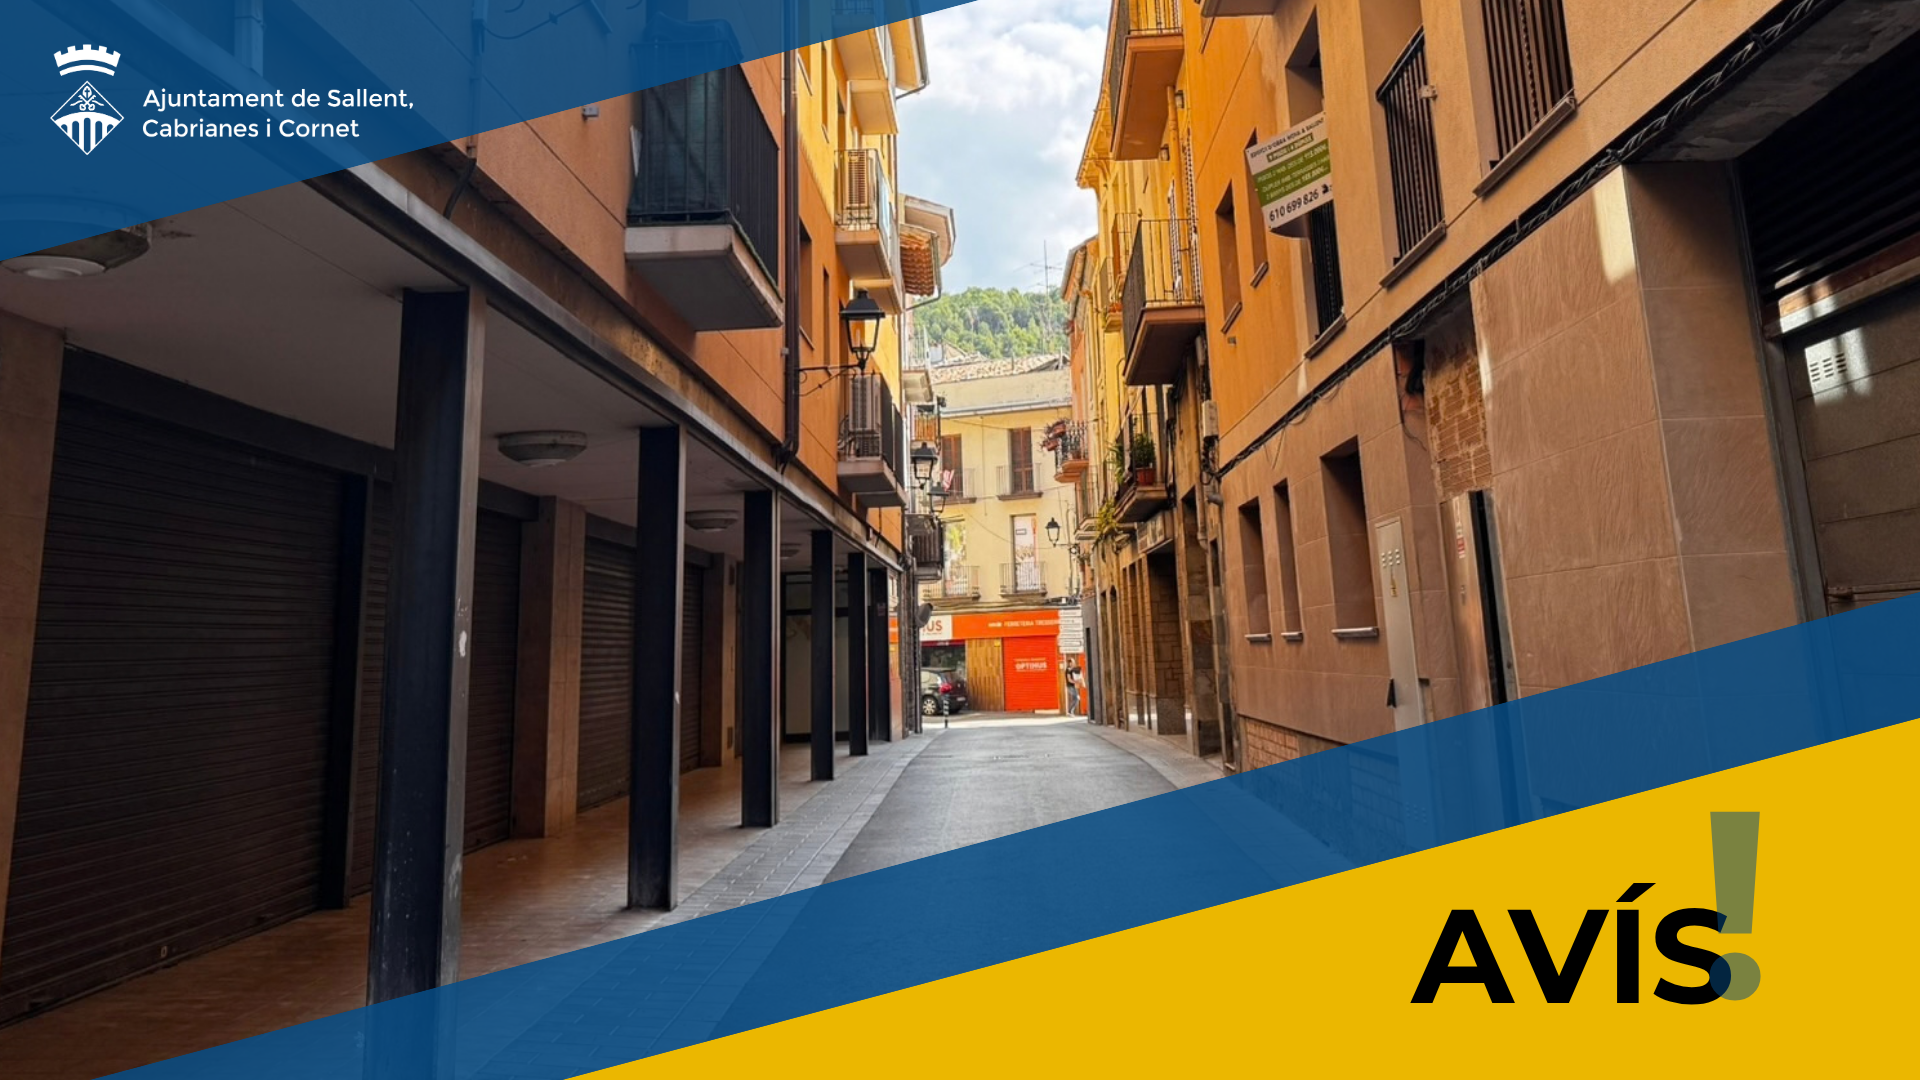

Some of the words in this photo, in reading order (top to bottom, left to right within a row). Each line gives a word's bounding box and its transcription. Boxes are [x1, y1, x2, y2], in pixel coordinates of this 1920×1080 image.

[1269, 206, 1285, 221] 610
[1287, 198, 1302, 213] 699
[1303, 189, 1319, 205] 826
